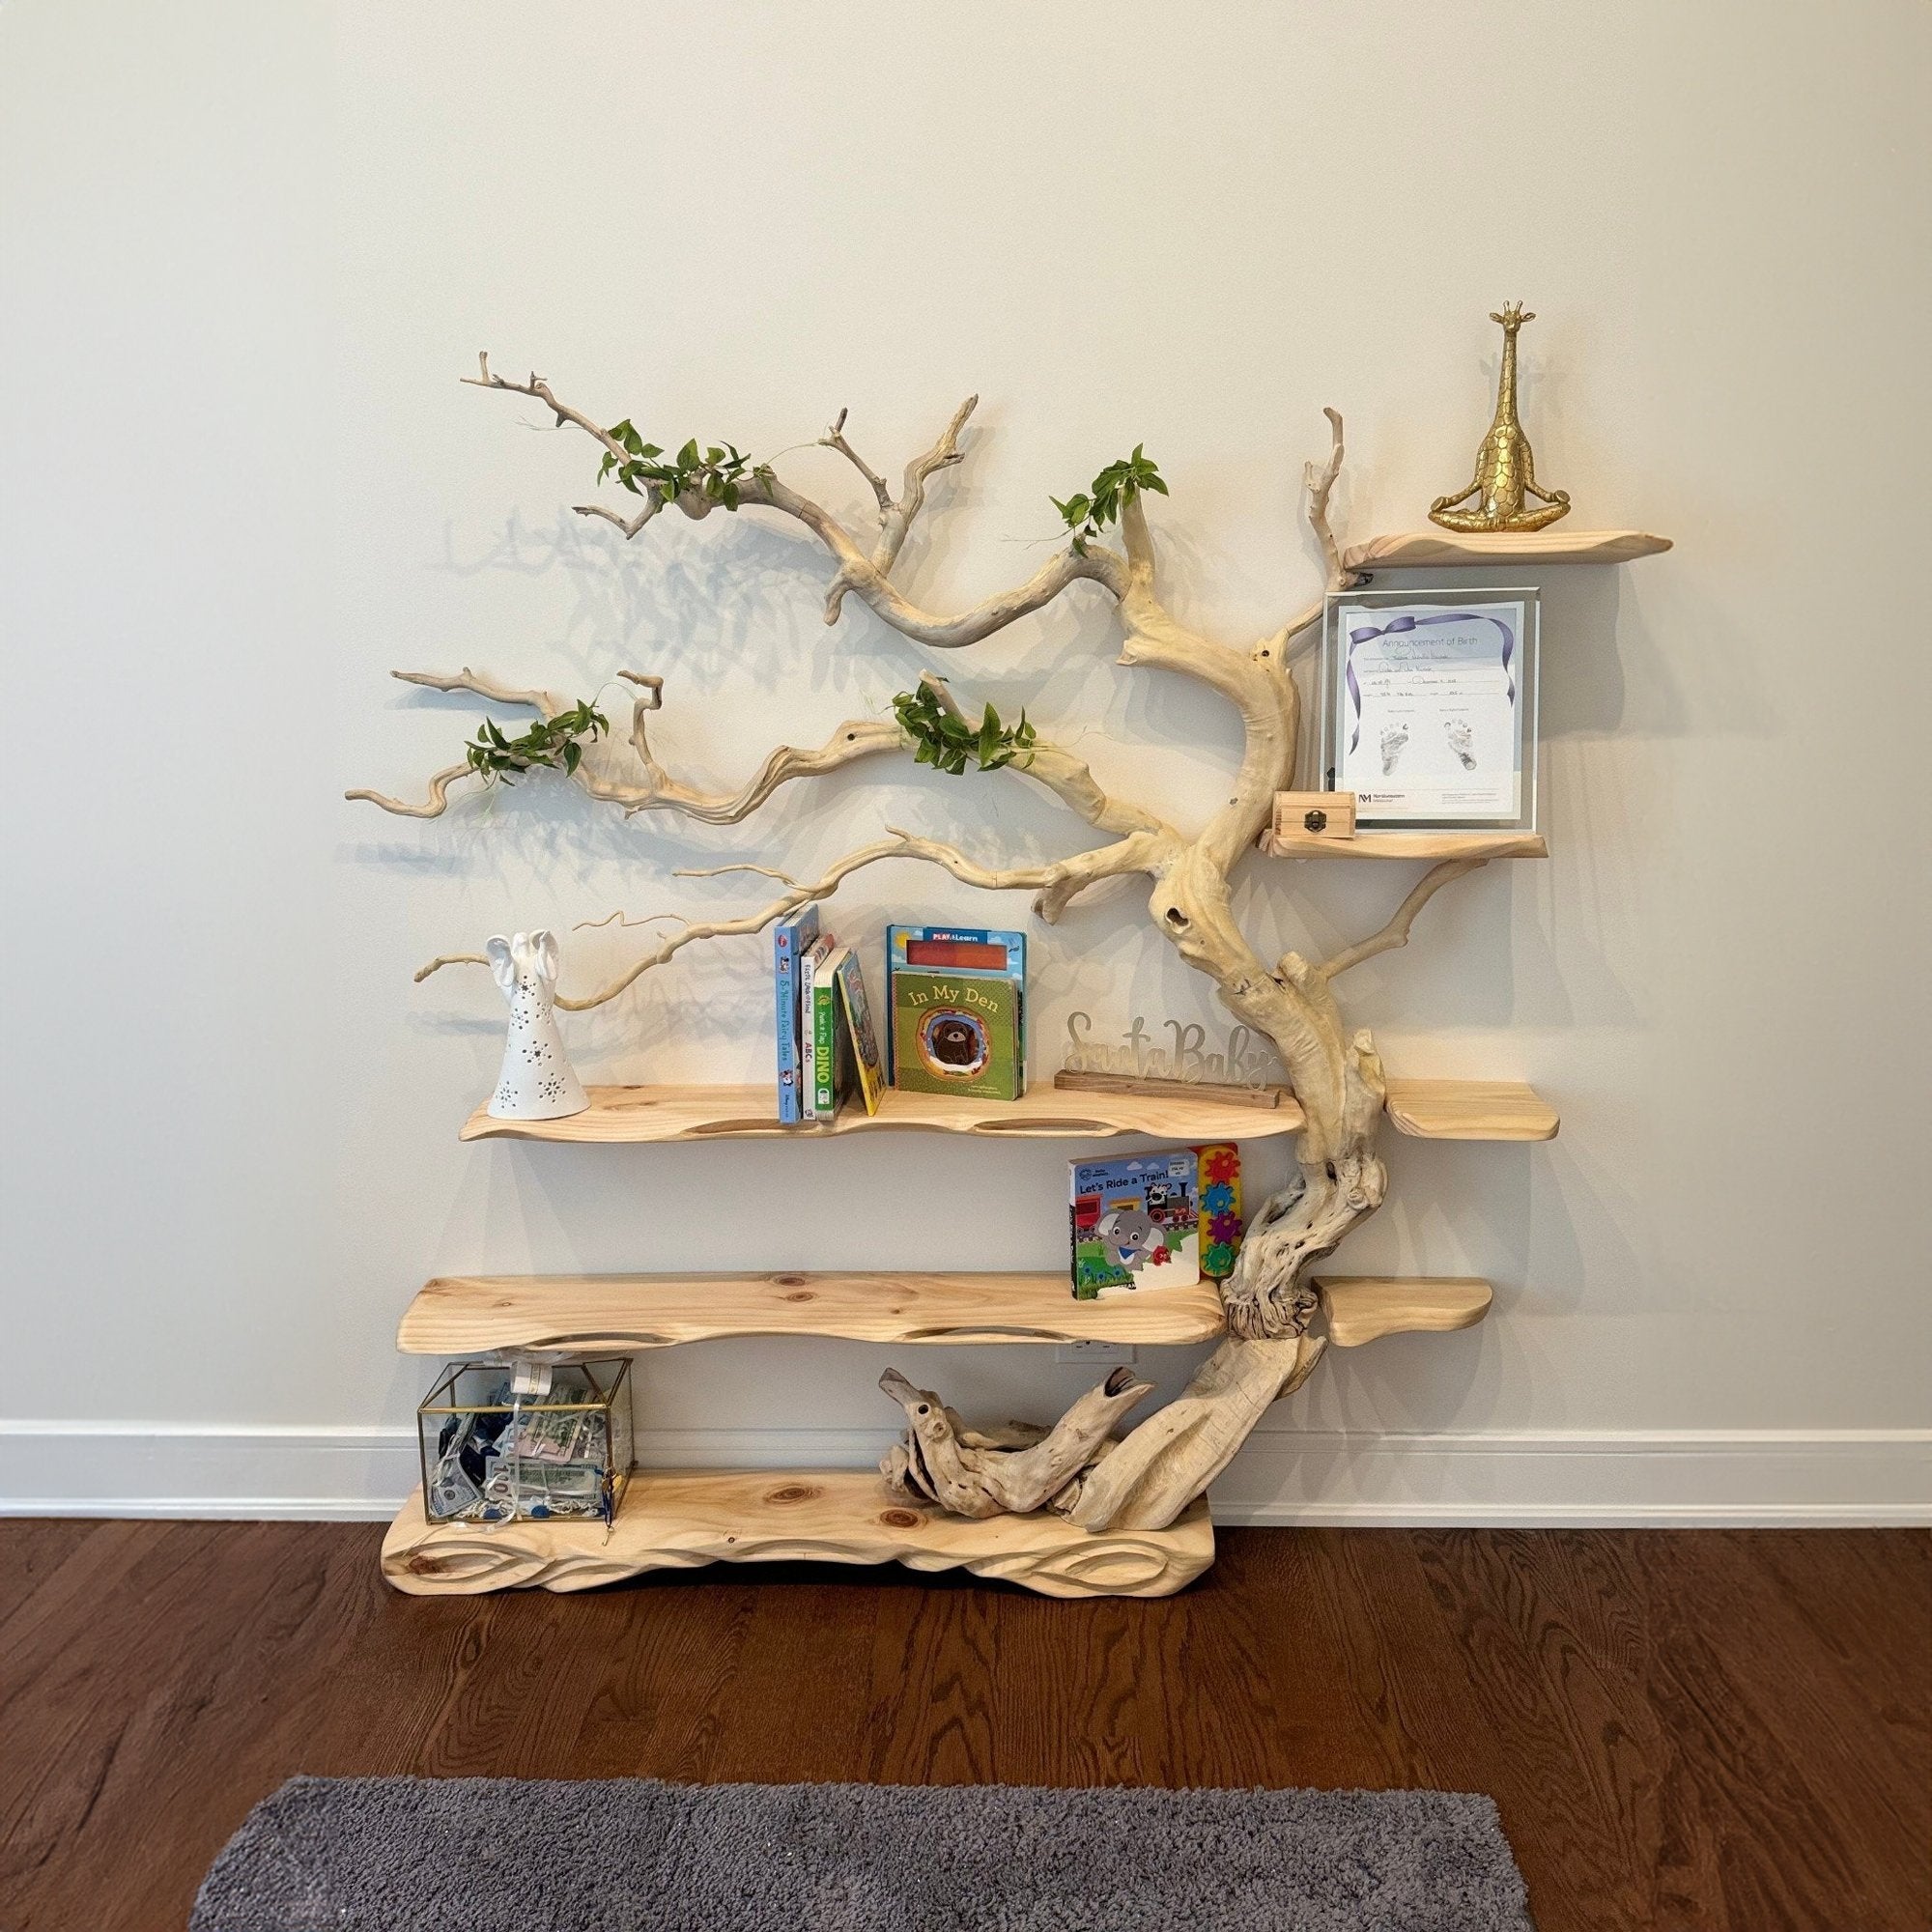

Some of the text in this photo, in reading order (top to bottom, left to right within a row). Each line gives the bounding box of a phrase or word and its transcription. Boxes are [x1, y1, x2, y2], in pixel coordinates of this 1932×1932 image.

[1382, 636, 1478, 648] Announcement of Birth
[908, 985, 999, 1013] In My Den
[1064, 1010, 1172, 1081] Santa
[816, 1046, 830, 1083] DINO
[1079, 1181, 1104, 1194] Let's
[1106, 1178, 1129, 1189] Ride
[1140, 1170, 1169, 1183] Train!
